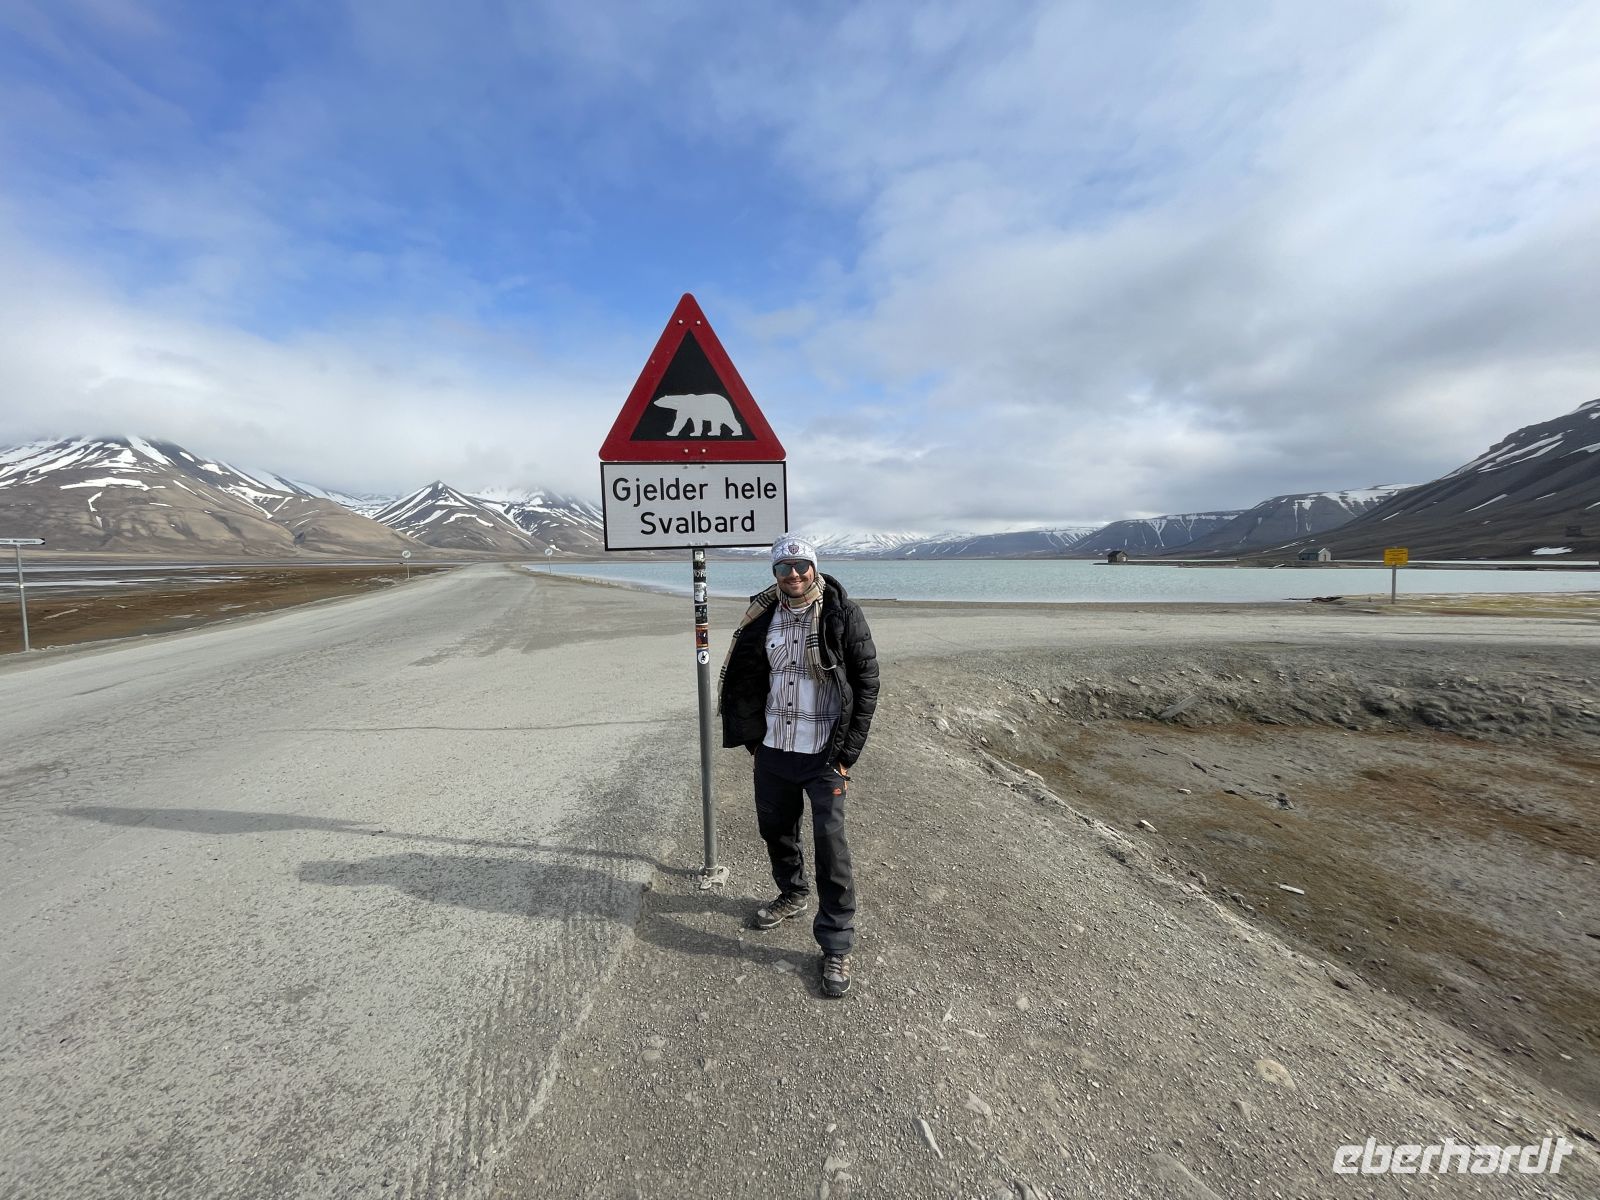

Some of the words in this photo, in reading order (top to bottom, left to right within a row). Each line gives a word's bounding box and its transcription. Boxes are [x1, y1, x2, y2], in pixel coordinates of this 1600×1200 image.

[612, 477, 708, 507] Gjelder
[725, 476, 777, 499] hele
[640, 510, 755, 535] Svalbard
